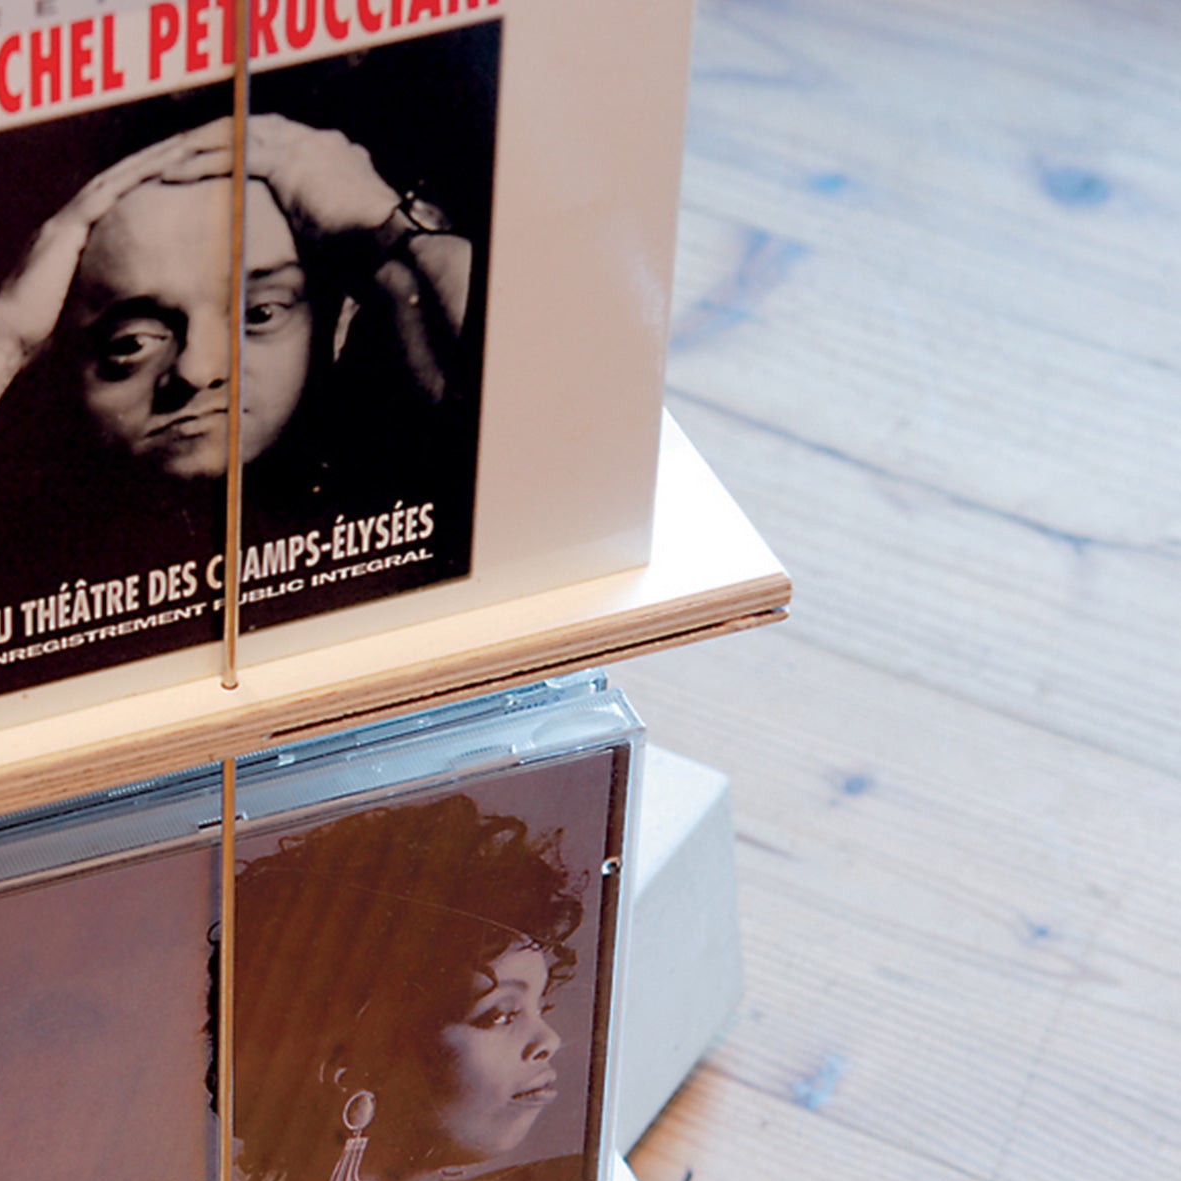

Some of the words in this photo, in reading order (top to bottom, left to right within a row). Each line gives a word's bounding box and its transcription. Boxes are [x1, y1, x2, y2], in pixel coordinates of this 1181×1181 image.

[19, 578, 140, 635] THÉÂTRE
[147, 560, 198, 608] DES
[205, 500, 434, 590] CAMPS-ÉLYSÉES
[311, 547, 434, 587] INTEGRAL
